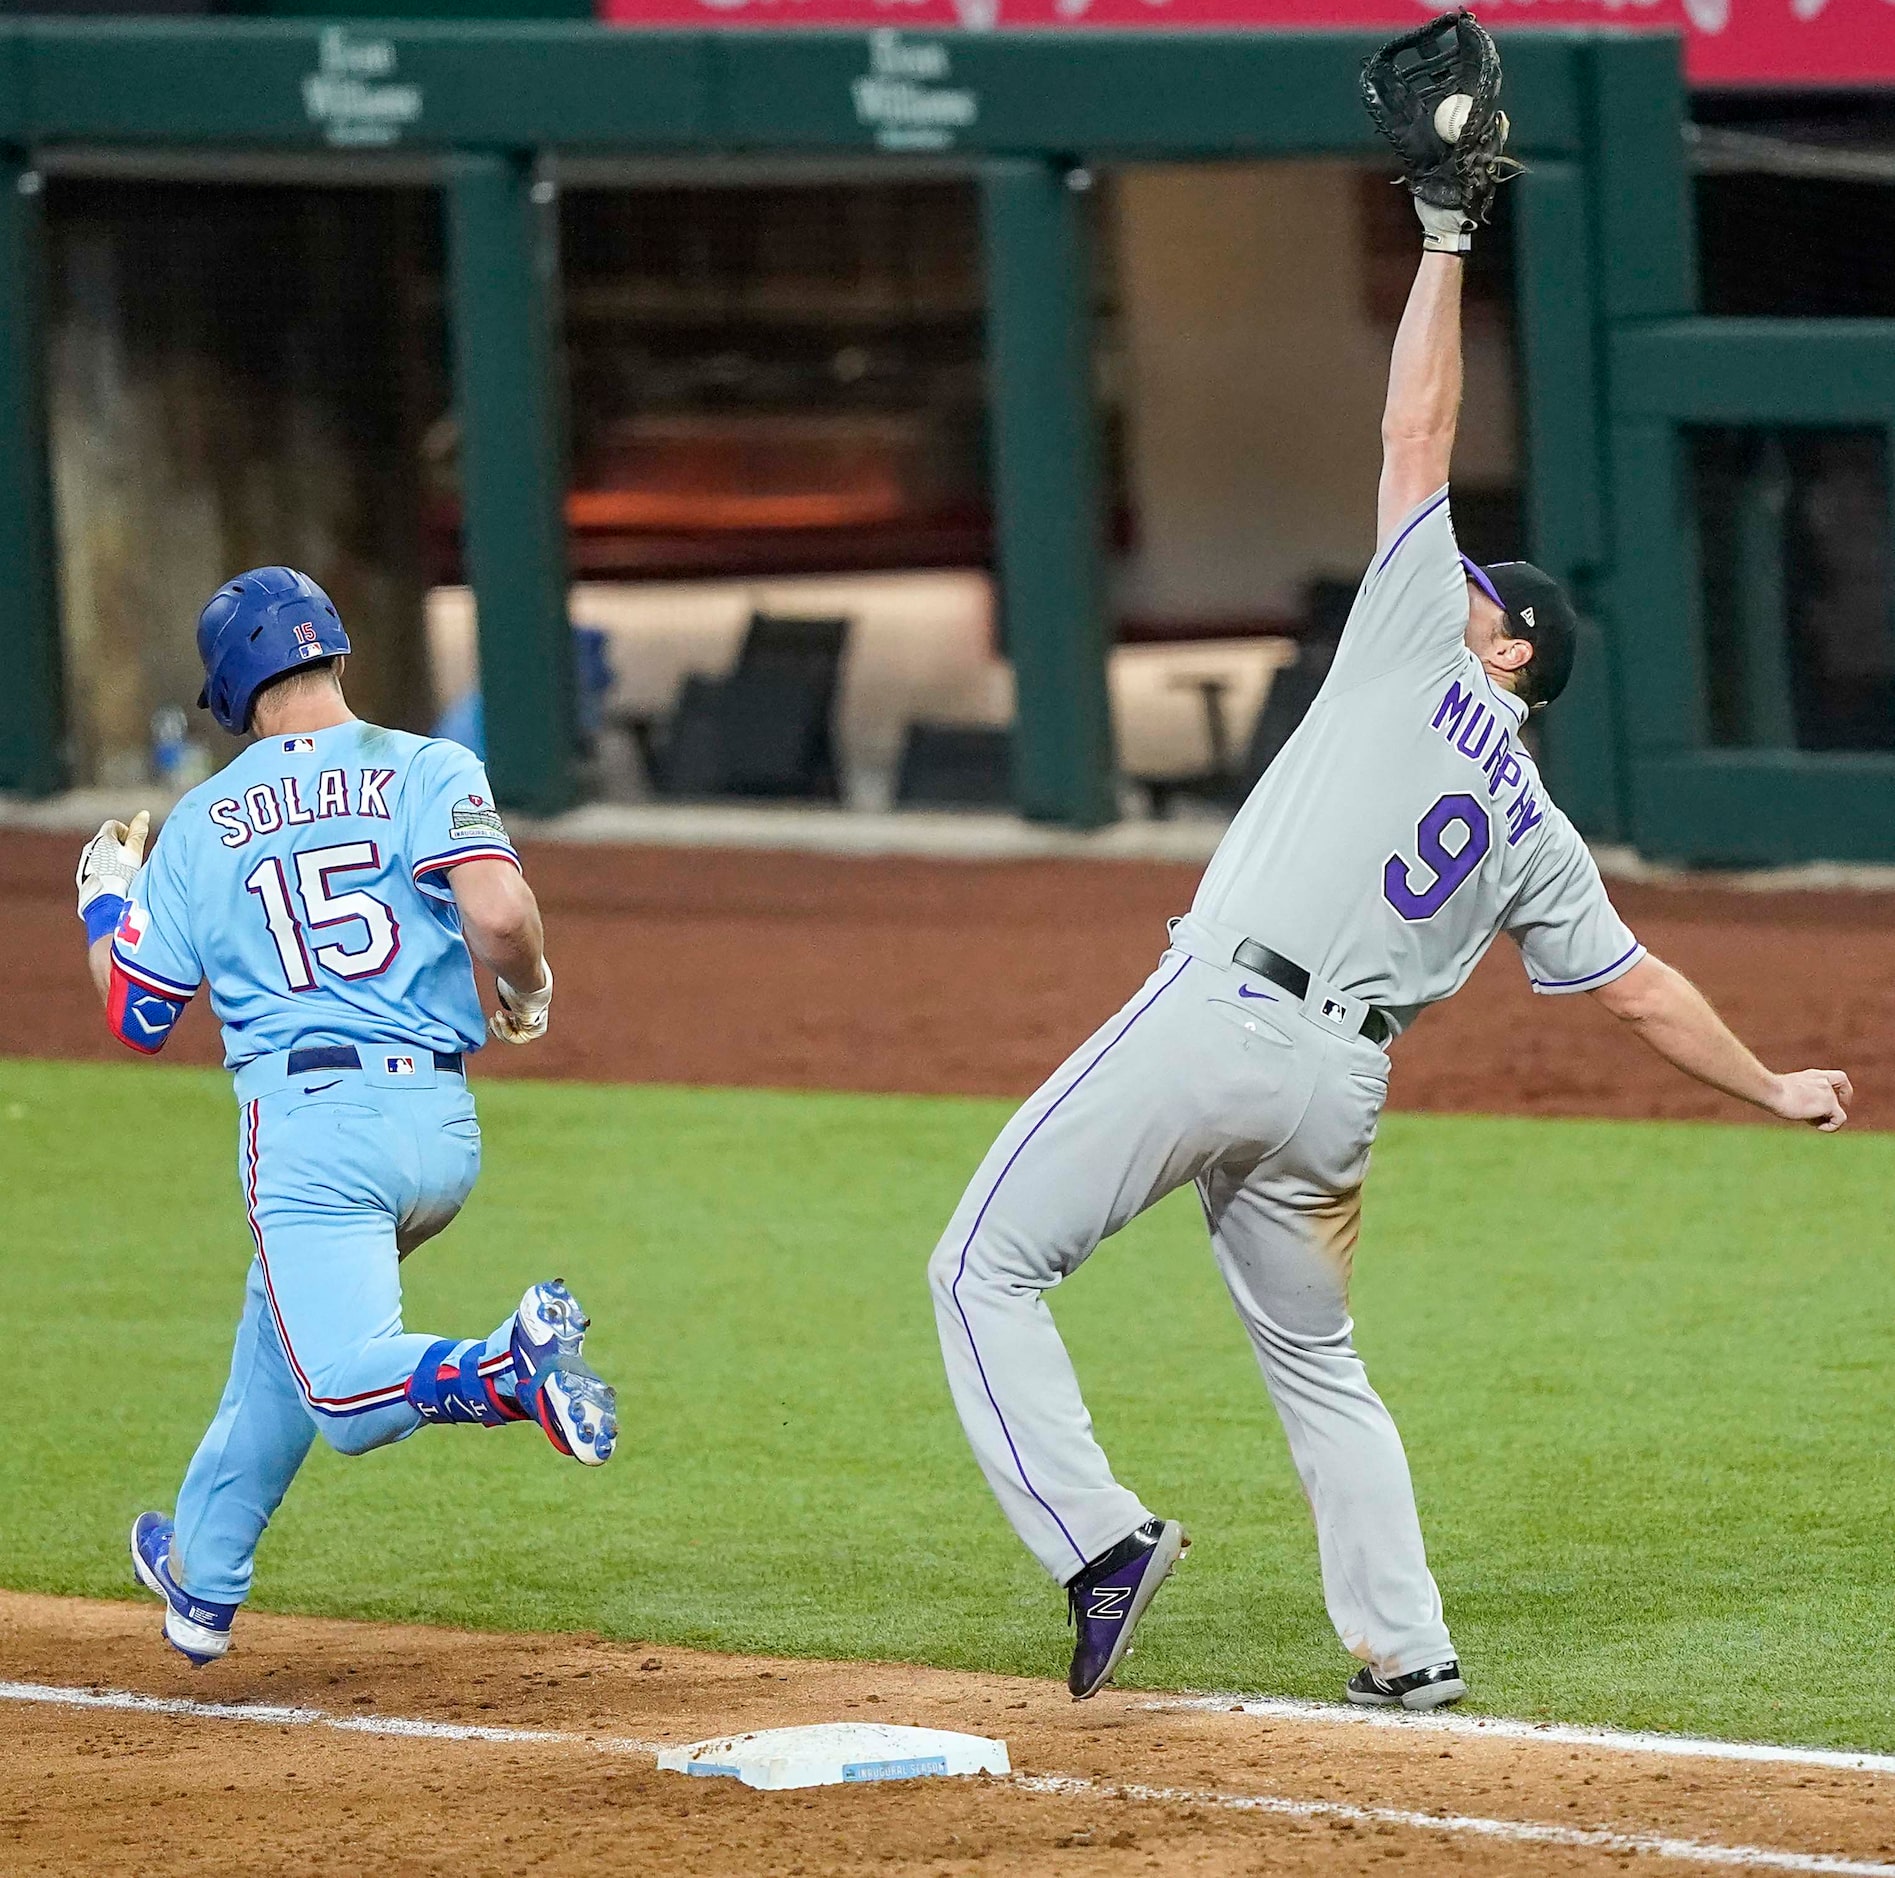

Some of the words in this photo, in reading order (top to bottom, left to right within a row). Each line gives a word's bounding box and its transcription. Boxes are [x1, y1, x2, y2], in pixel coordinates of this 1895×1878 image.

[292, 621, 317, 645] 15
[209, 768, 396, 848] SOLAK
[1381, 790, 1492, 923] 9
[245, 840, 401, 993] 15
[1087, 1587, 1132, 1619] N
[857, 1765, 909, 1779] INAUGURAL
[910, 1761, 945, 1775] SEASON
